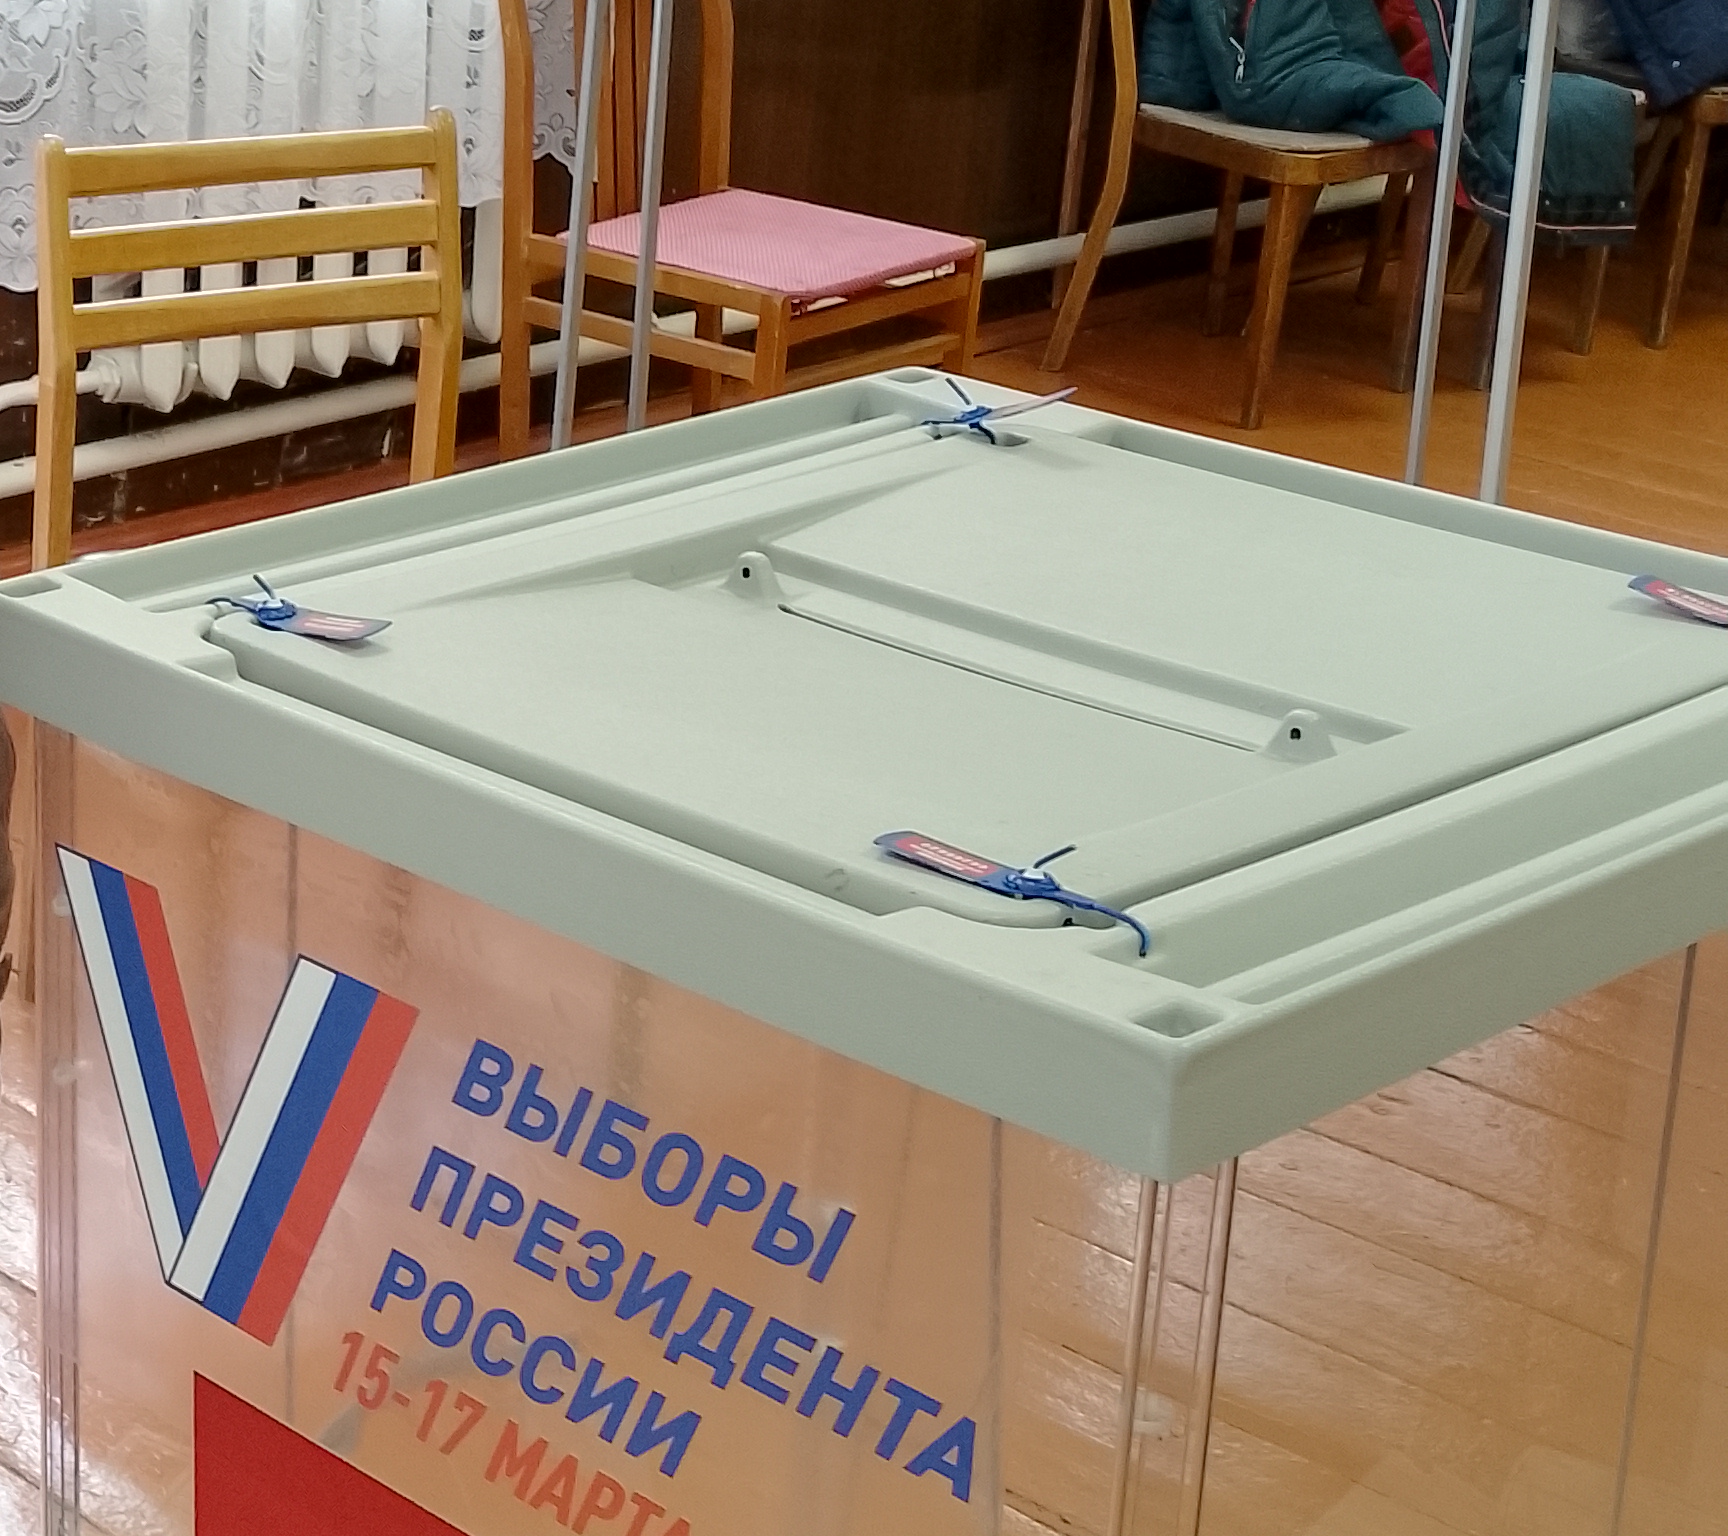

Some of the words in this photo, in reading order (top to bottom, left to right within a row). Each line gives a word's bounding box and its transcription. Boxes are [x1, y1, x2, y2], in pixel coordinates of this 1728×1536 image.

[450, 1036, 858, 1284] ВЫБОРЫ
[369, 1248, 704, 1479] РОССИИ
[409, 1144, 979, 1503] ПРЕЗИДЕНТА
